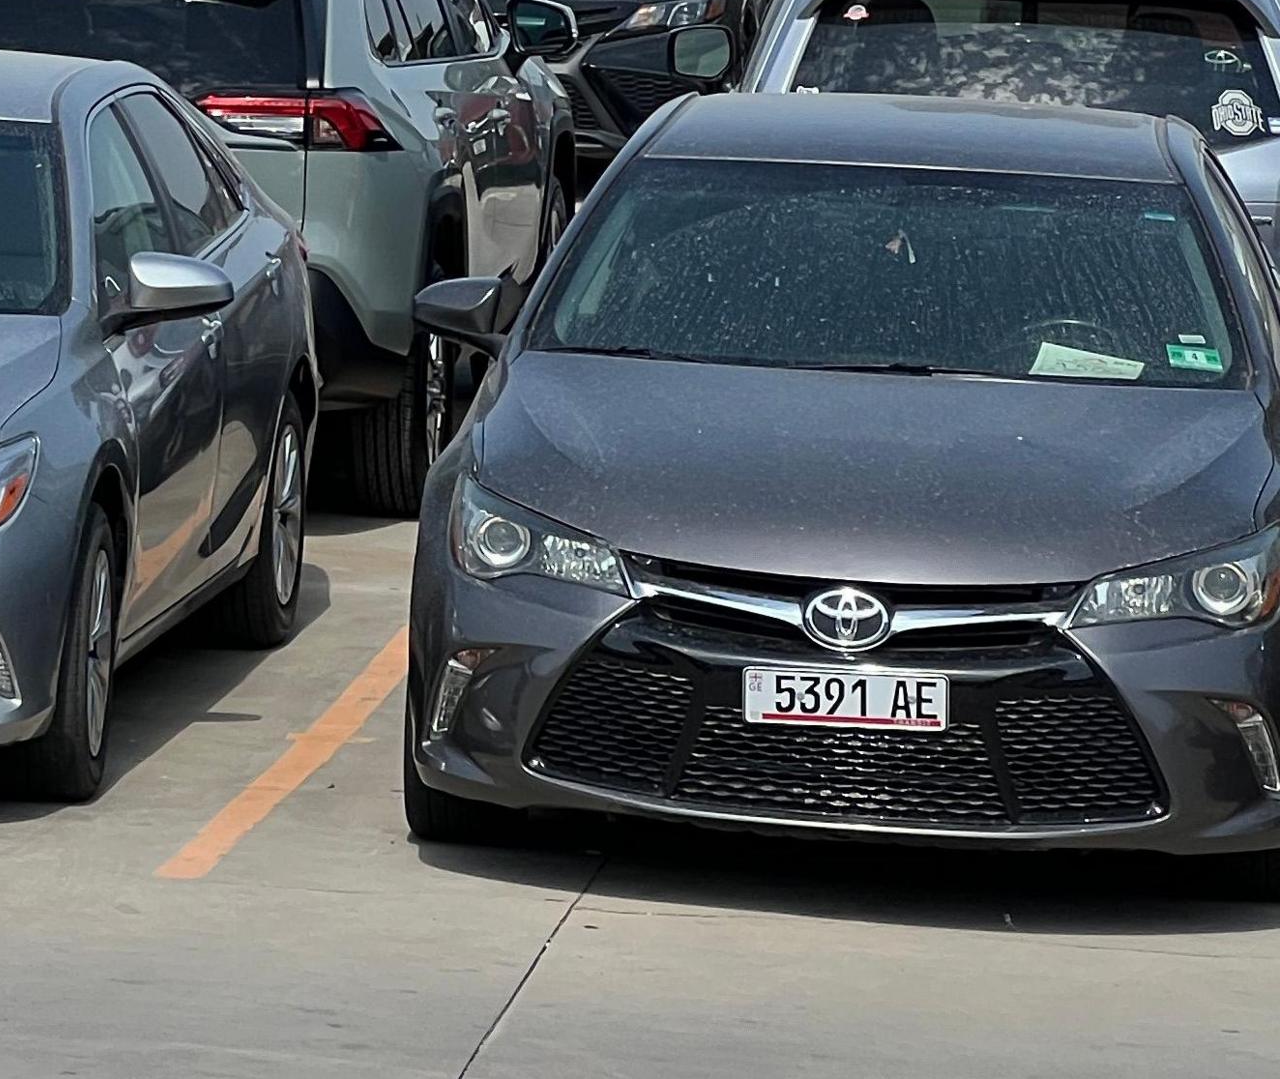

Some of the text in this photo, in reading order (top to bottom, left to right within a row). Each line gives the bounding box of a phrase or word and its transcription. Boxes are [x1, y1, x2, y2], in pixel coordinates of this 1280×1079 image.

[748, 682, 763, 692] GE
[775, 675, 938, 719] 5391 AE
